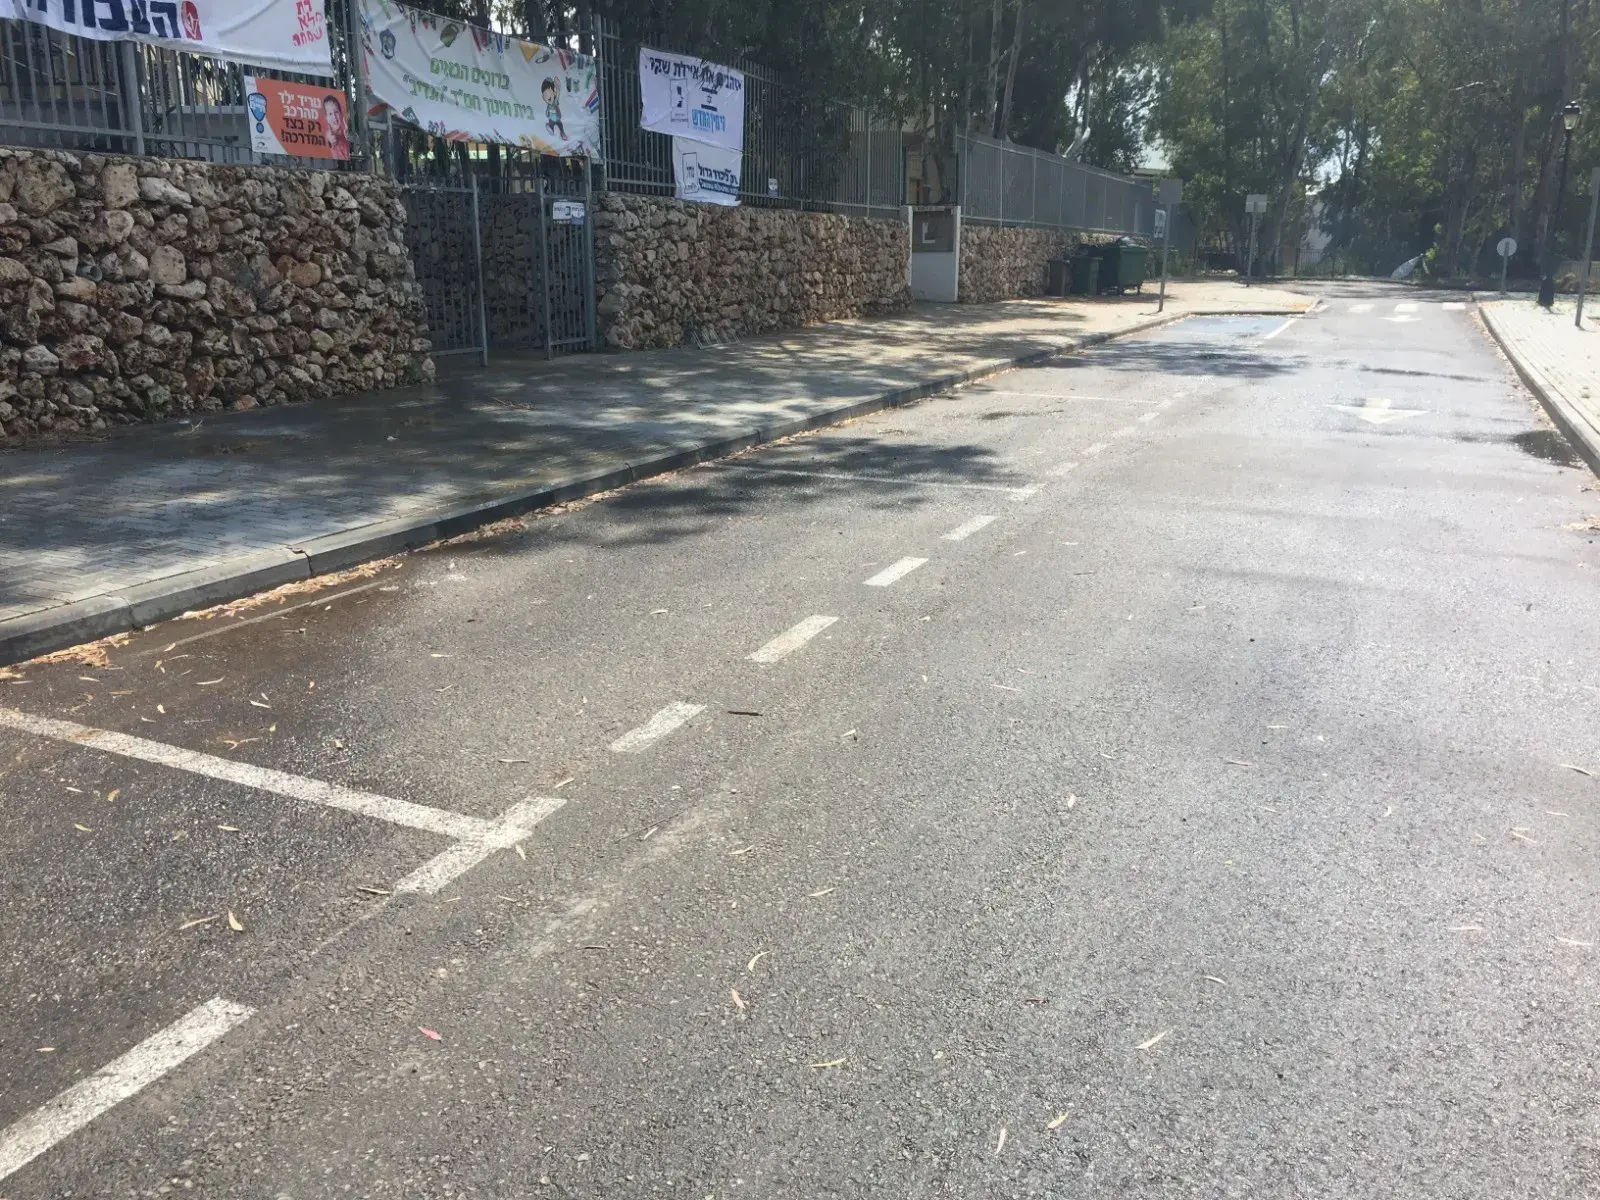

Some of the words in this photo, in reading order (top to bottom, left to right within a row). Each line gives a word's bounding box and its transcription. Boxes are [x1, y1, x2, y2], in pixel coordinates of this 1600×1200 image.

[430, 57, 469, 81] הבאים
[470, 67, 510, 90] ברוכים
[277, 89, 295, 105] ילד
[283, 104, 319, 120] מהרכב
[513, 102, 535, 120] בית
[282, 117, 305, 130] בצד
[307, 120, 322, 133] רק
